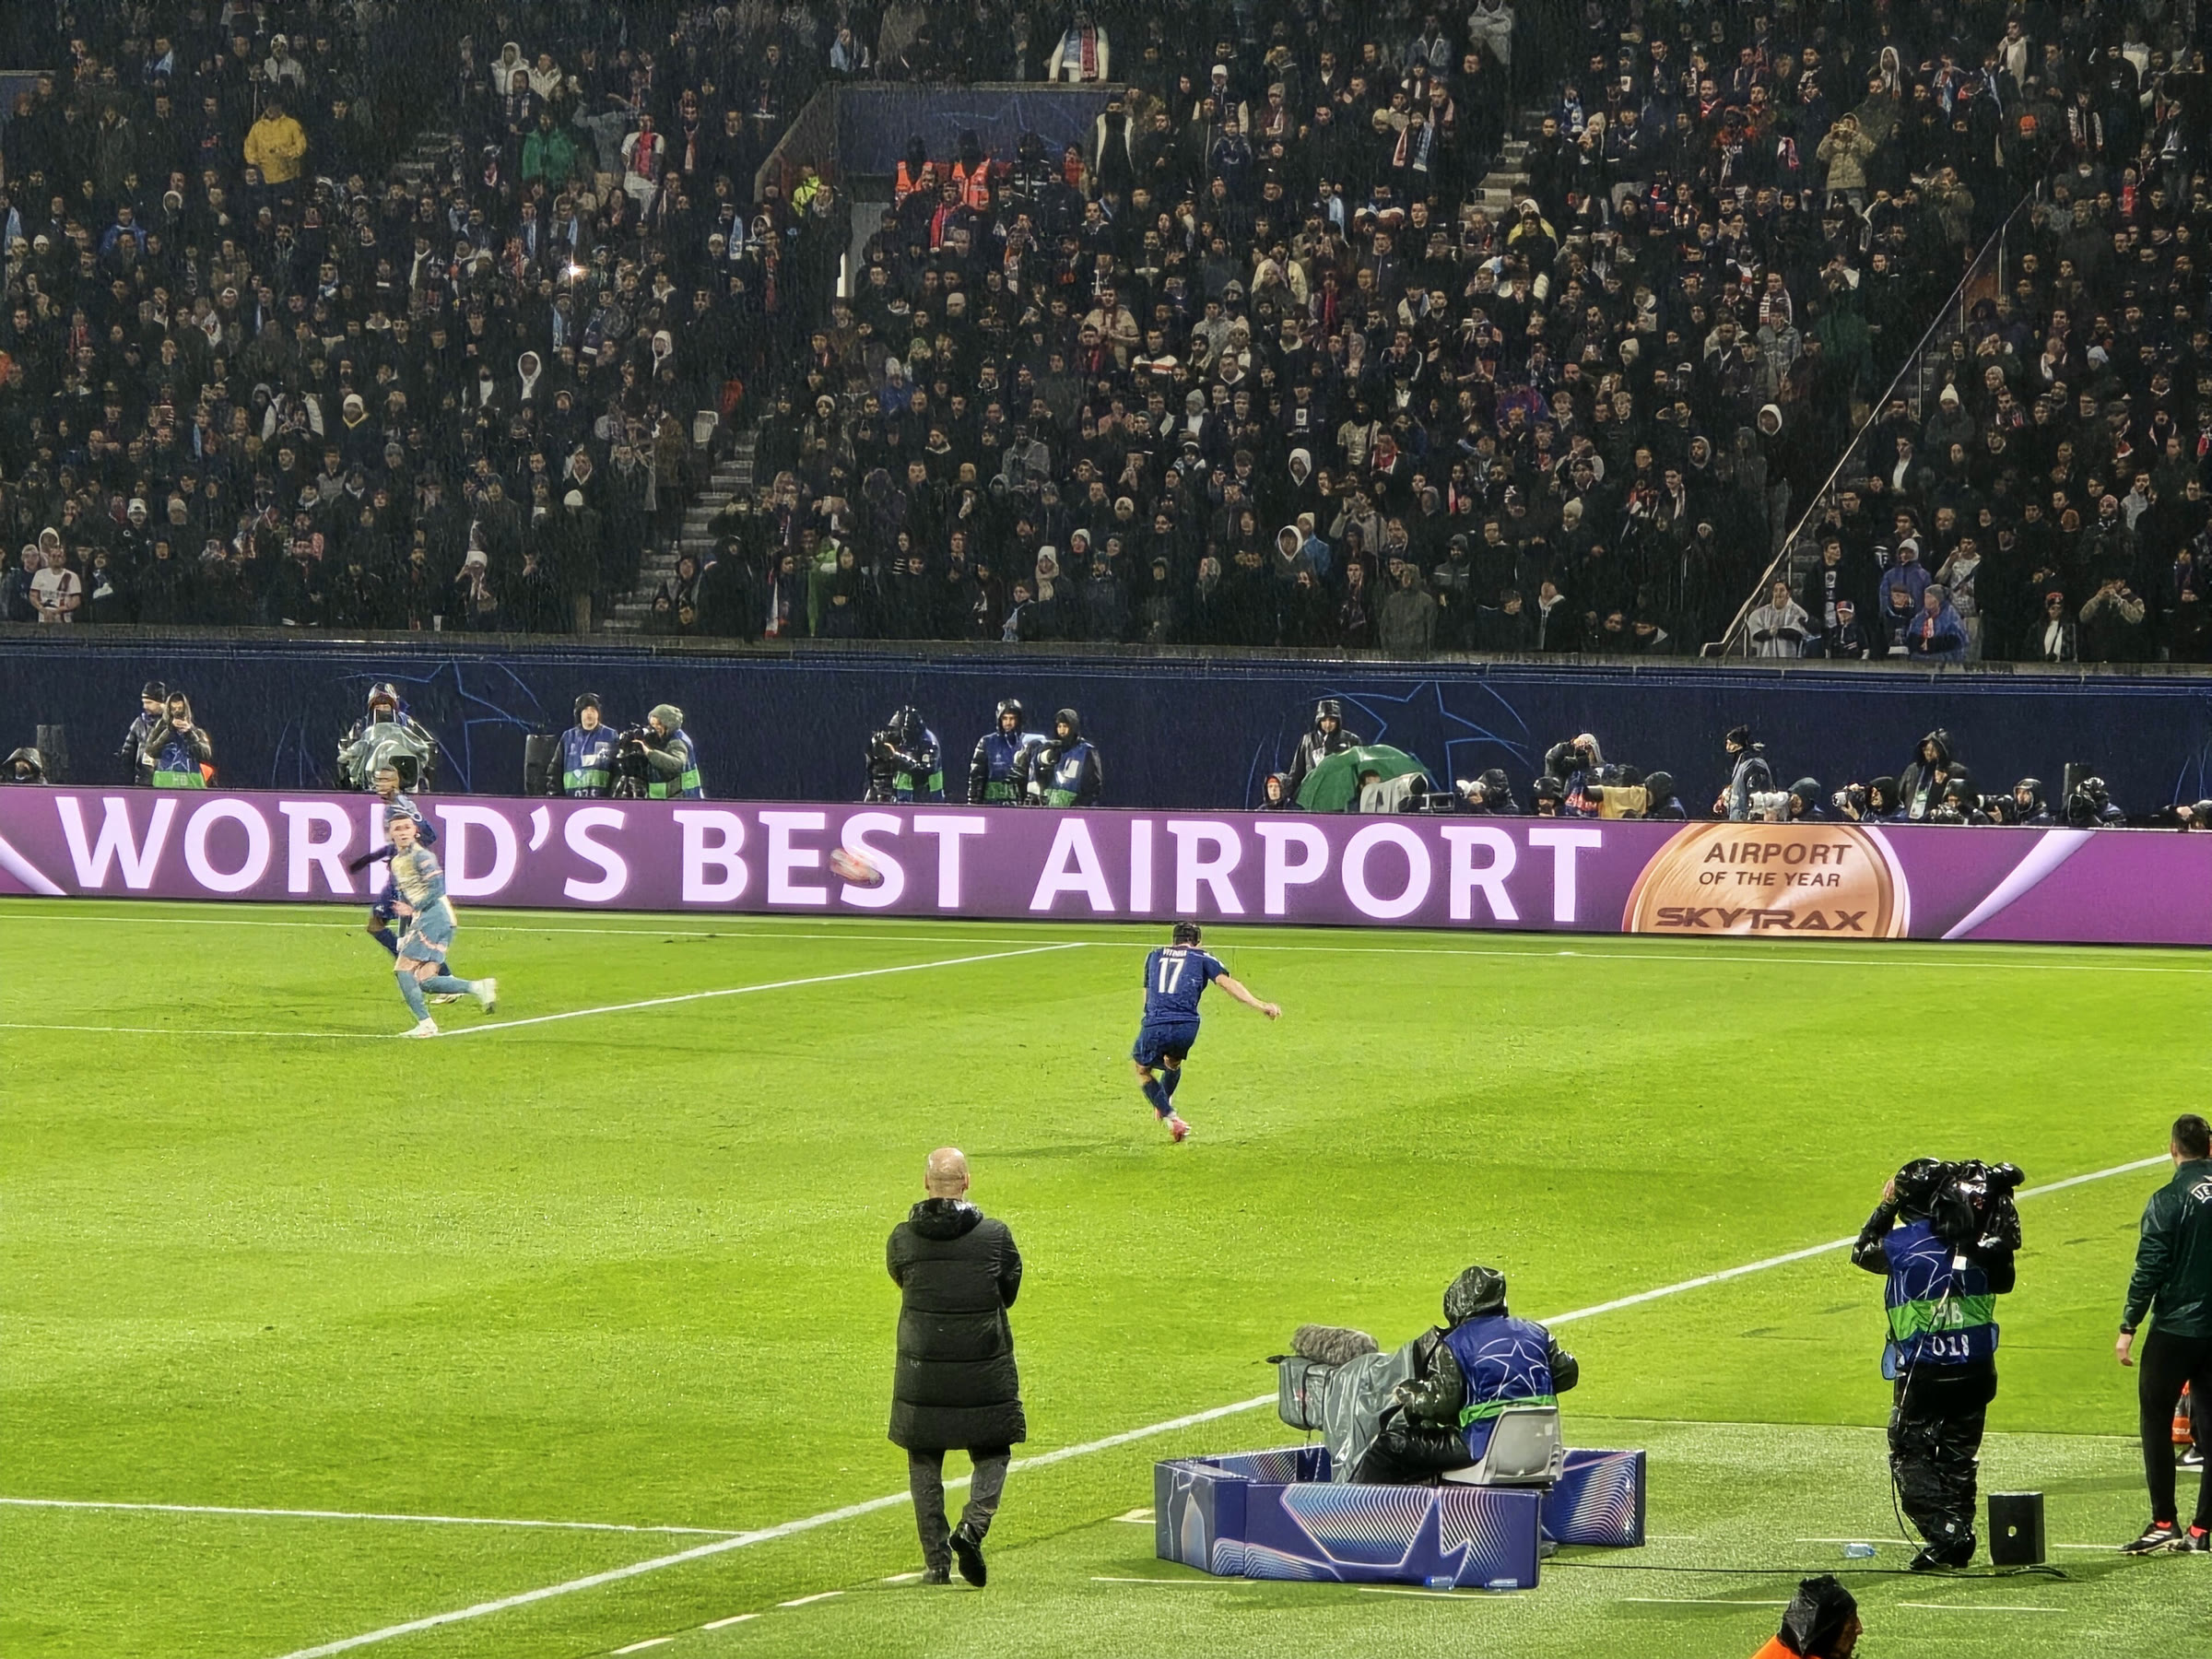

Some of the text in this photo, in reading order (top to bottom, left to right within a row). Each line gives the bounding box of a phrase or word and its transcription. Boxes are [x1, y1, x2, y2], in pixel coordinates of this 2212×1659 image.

[1703, 842, 1852, 865] AIRPORT
[673, 809, 986, 908] BEST
[1029, 818, 1602, 923] AIRPORT
[1699, 871, 1841, 887] OF THE YEAR
[1654, 907, 1867, 931] SKYTRAX
[1159, 958, 1184, 994] 17
